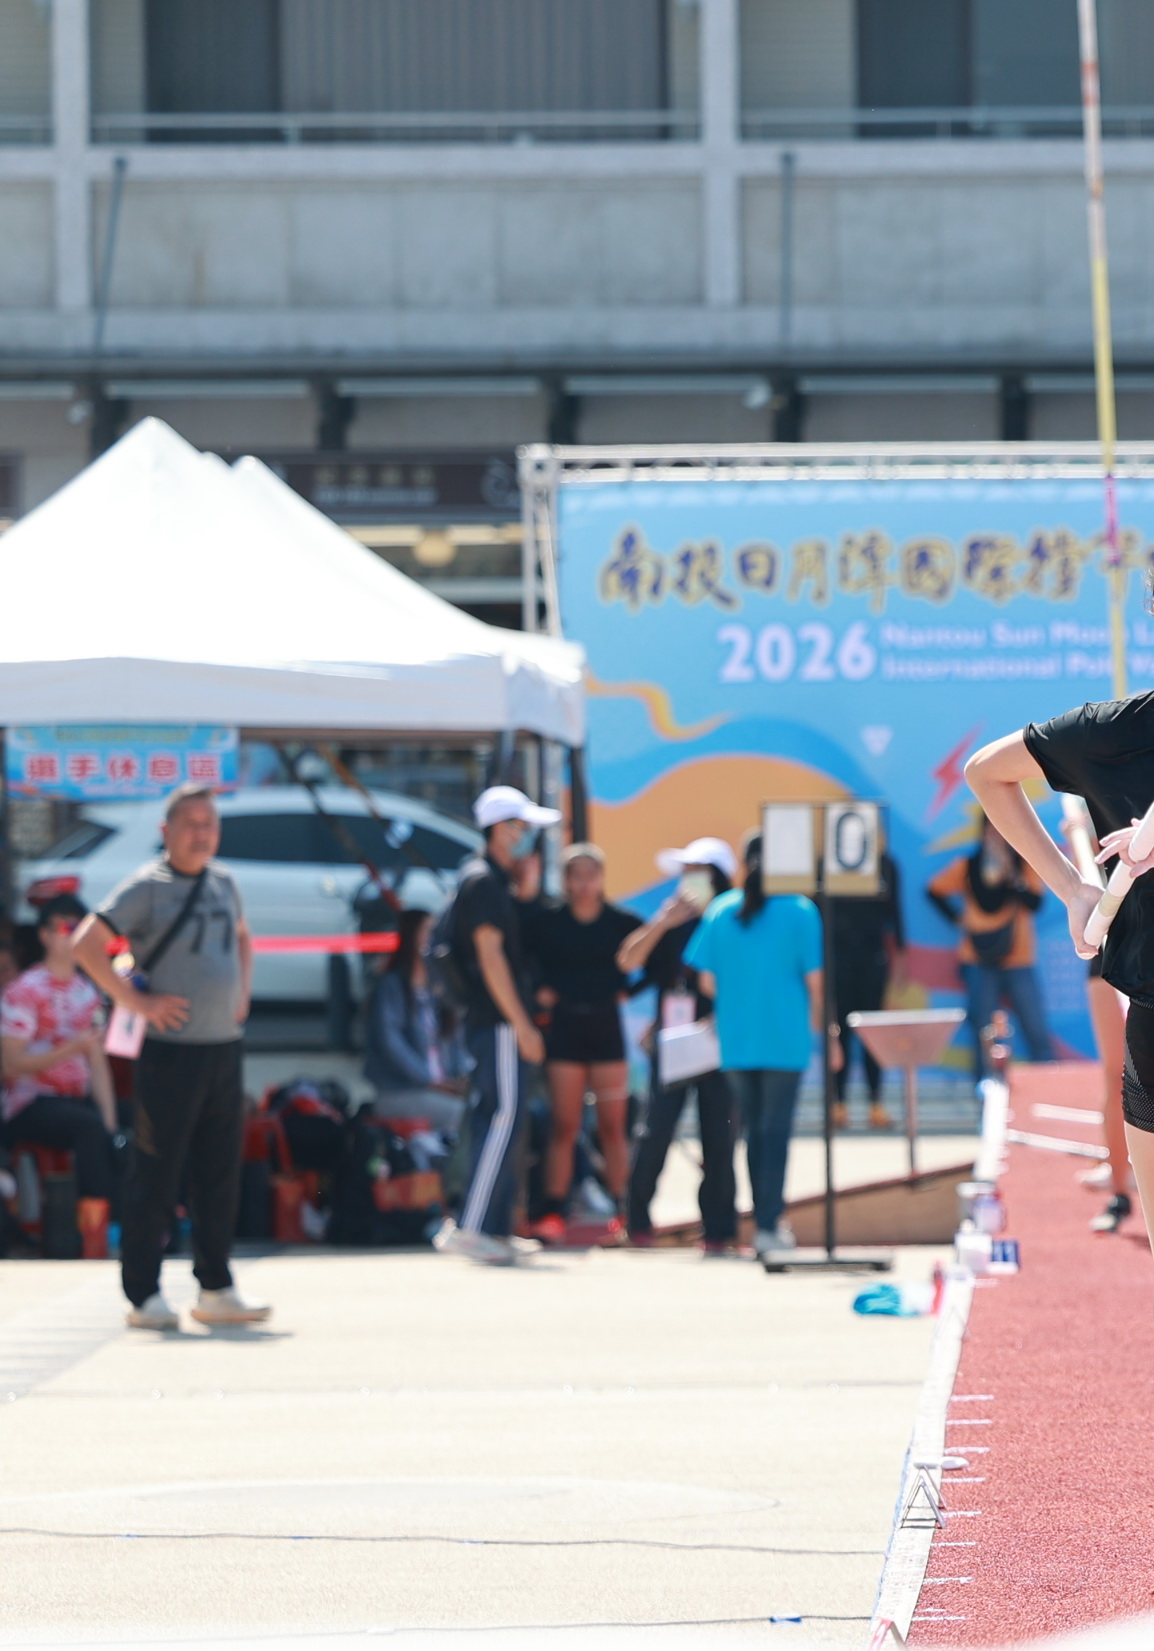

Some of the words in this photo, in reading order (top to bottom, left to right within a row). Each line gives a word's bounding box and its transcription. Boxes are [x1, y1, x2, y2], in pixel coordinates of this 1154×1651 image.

[717, 622, 878, 683] 2026
[881, 620, 986, 646] Nantou
[992, 620, 1046, 646] Sun
[1050, 621, 1129, 645] Moo
[882, 653, 1061, 680] International
[1066, 651, 1125, 677] Pol
[836, 810, 867, 870] 0
